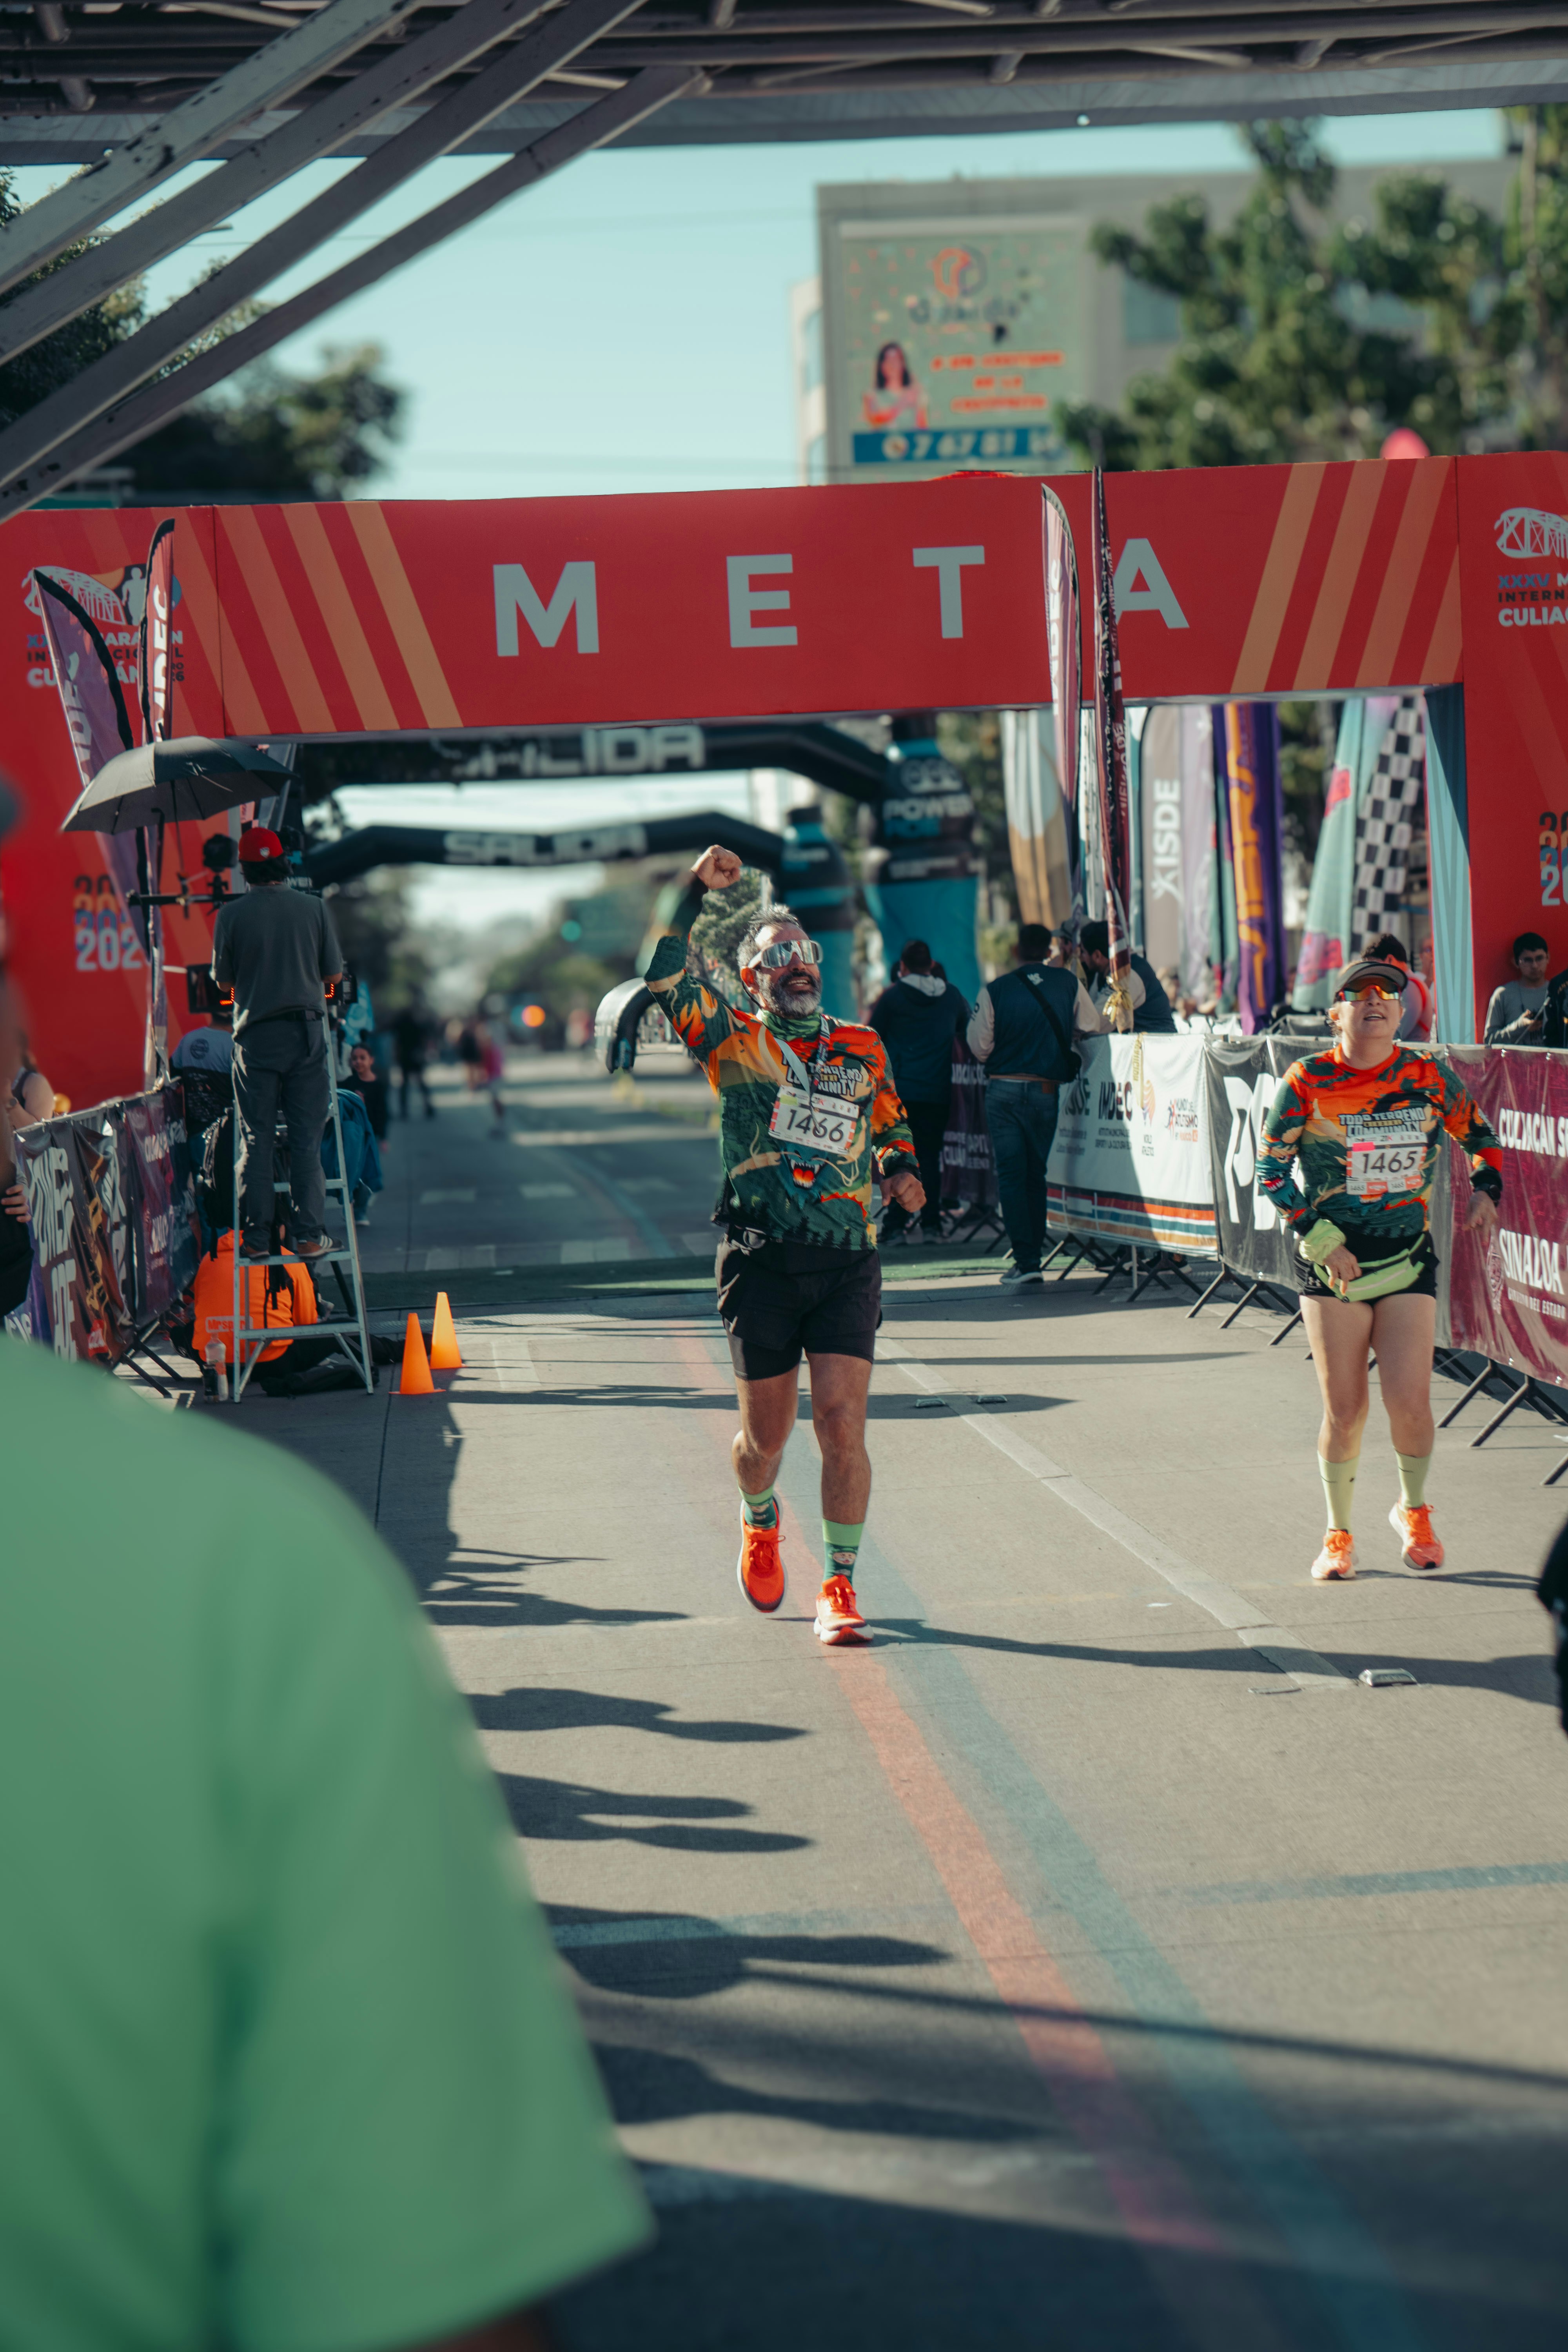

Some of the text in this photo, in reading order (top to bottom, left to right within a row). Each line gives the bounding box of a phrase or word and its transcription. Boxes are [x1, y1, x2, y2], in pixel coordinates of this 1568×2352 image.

[493, 538, 1190, 657] META
[1498, 574, 1550, 588] XXXV
[1498, 589, 1568, 603] INTERN
[1498, 606, 1568, 627] CULIA
[1153, 779, 1181, 866] ISDE
[76, 927, 142, 971] 202
[787, 1109, 844, 1142] 1466
[1338, 1114, 1372, 1125] TODO
[1372, 1107, 1426, 1122] TERRENO
[1499, 1103, 1556, 1156] CULIACÁN
[1362, 1151, 1418, 1174] 1465
[1499, 1228, 1564, 1295] SINALOA
